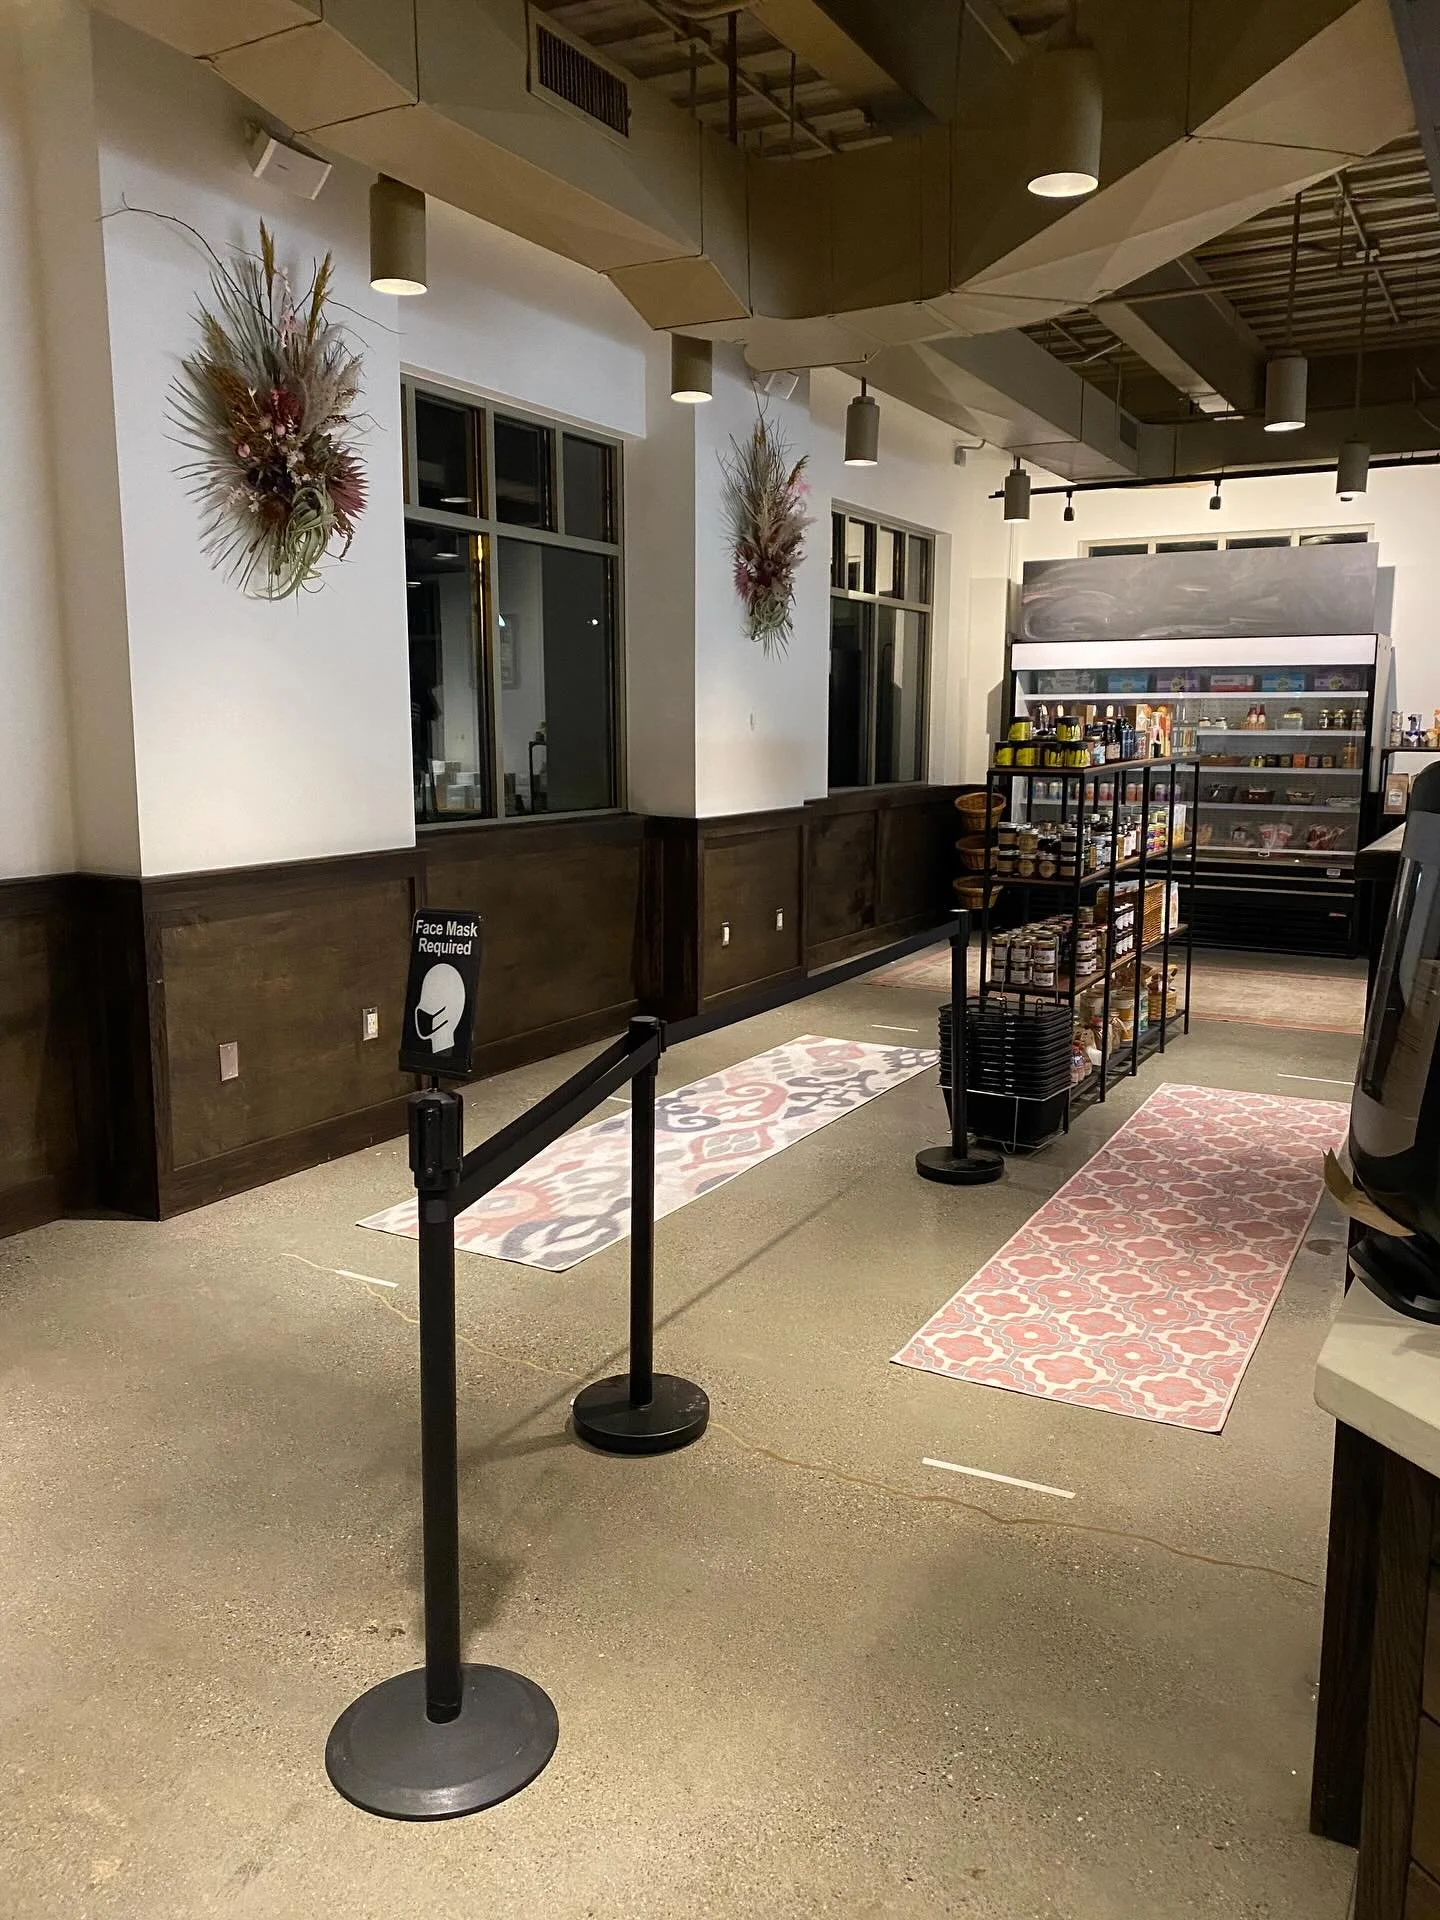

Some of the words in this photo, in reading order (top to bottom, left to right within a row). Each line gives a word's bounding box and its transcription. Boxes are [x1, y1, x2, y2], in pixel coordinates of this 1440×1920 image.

[416, 920, 443, 935] Face
[446, 921, 478, 937] Mask
[418, 938, 472, 957] Required
